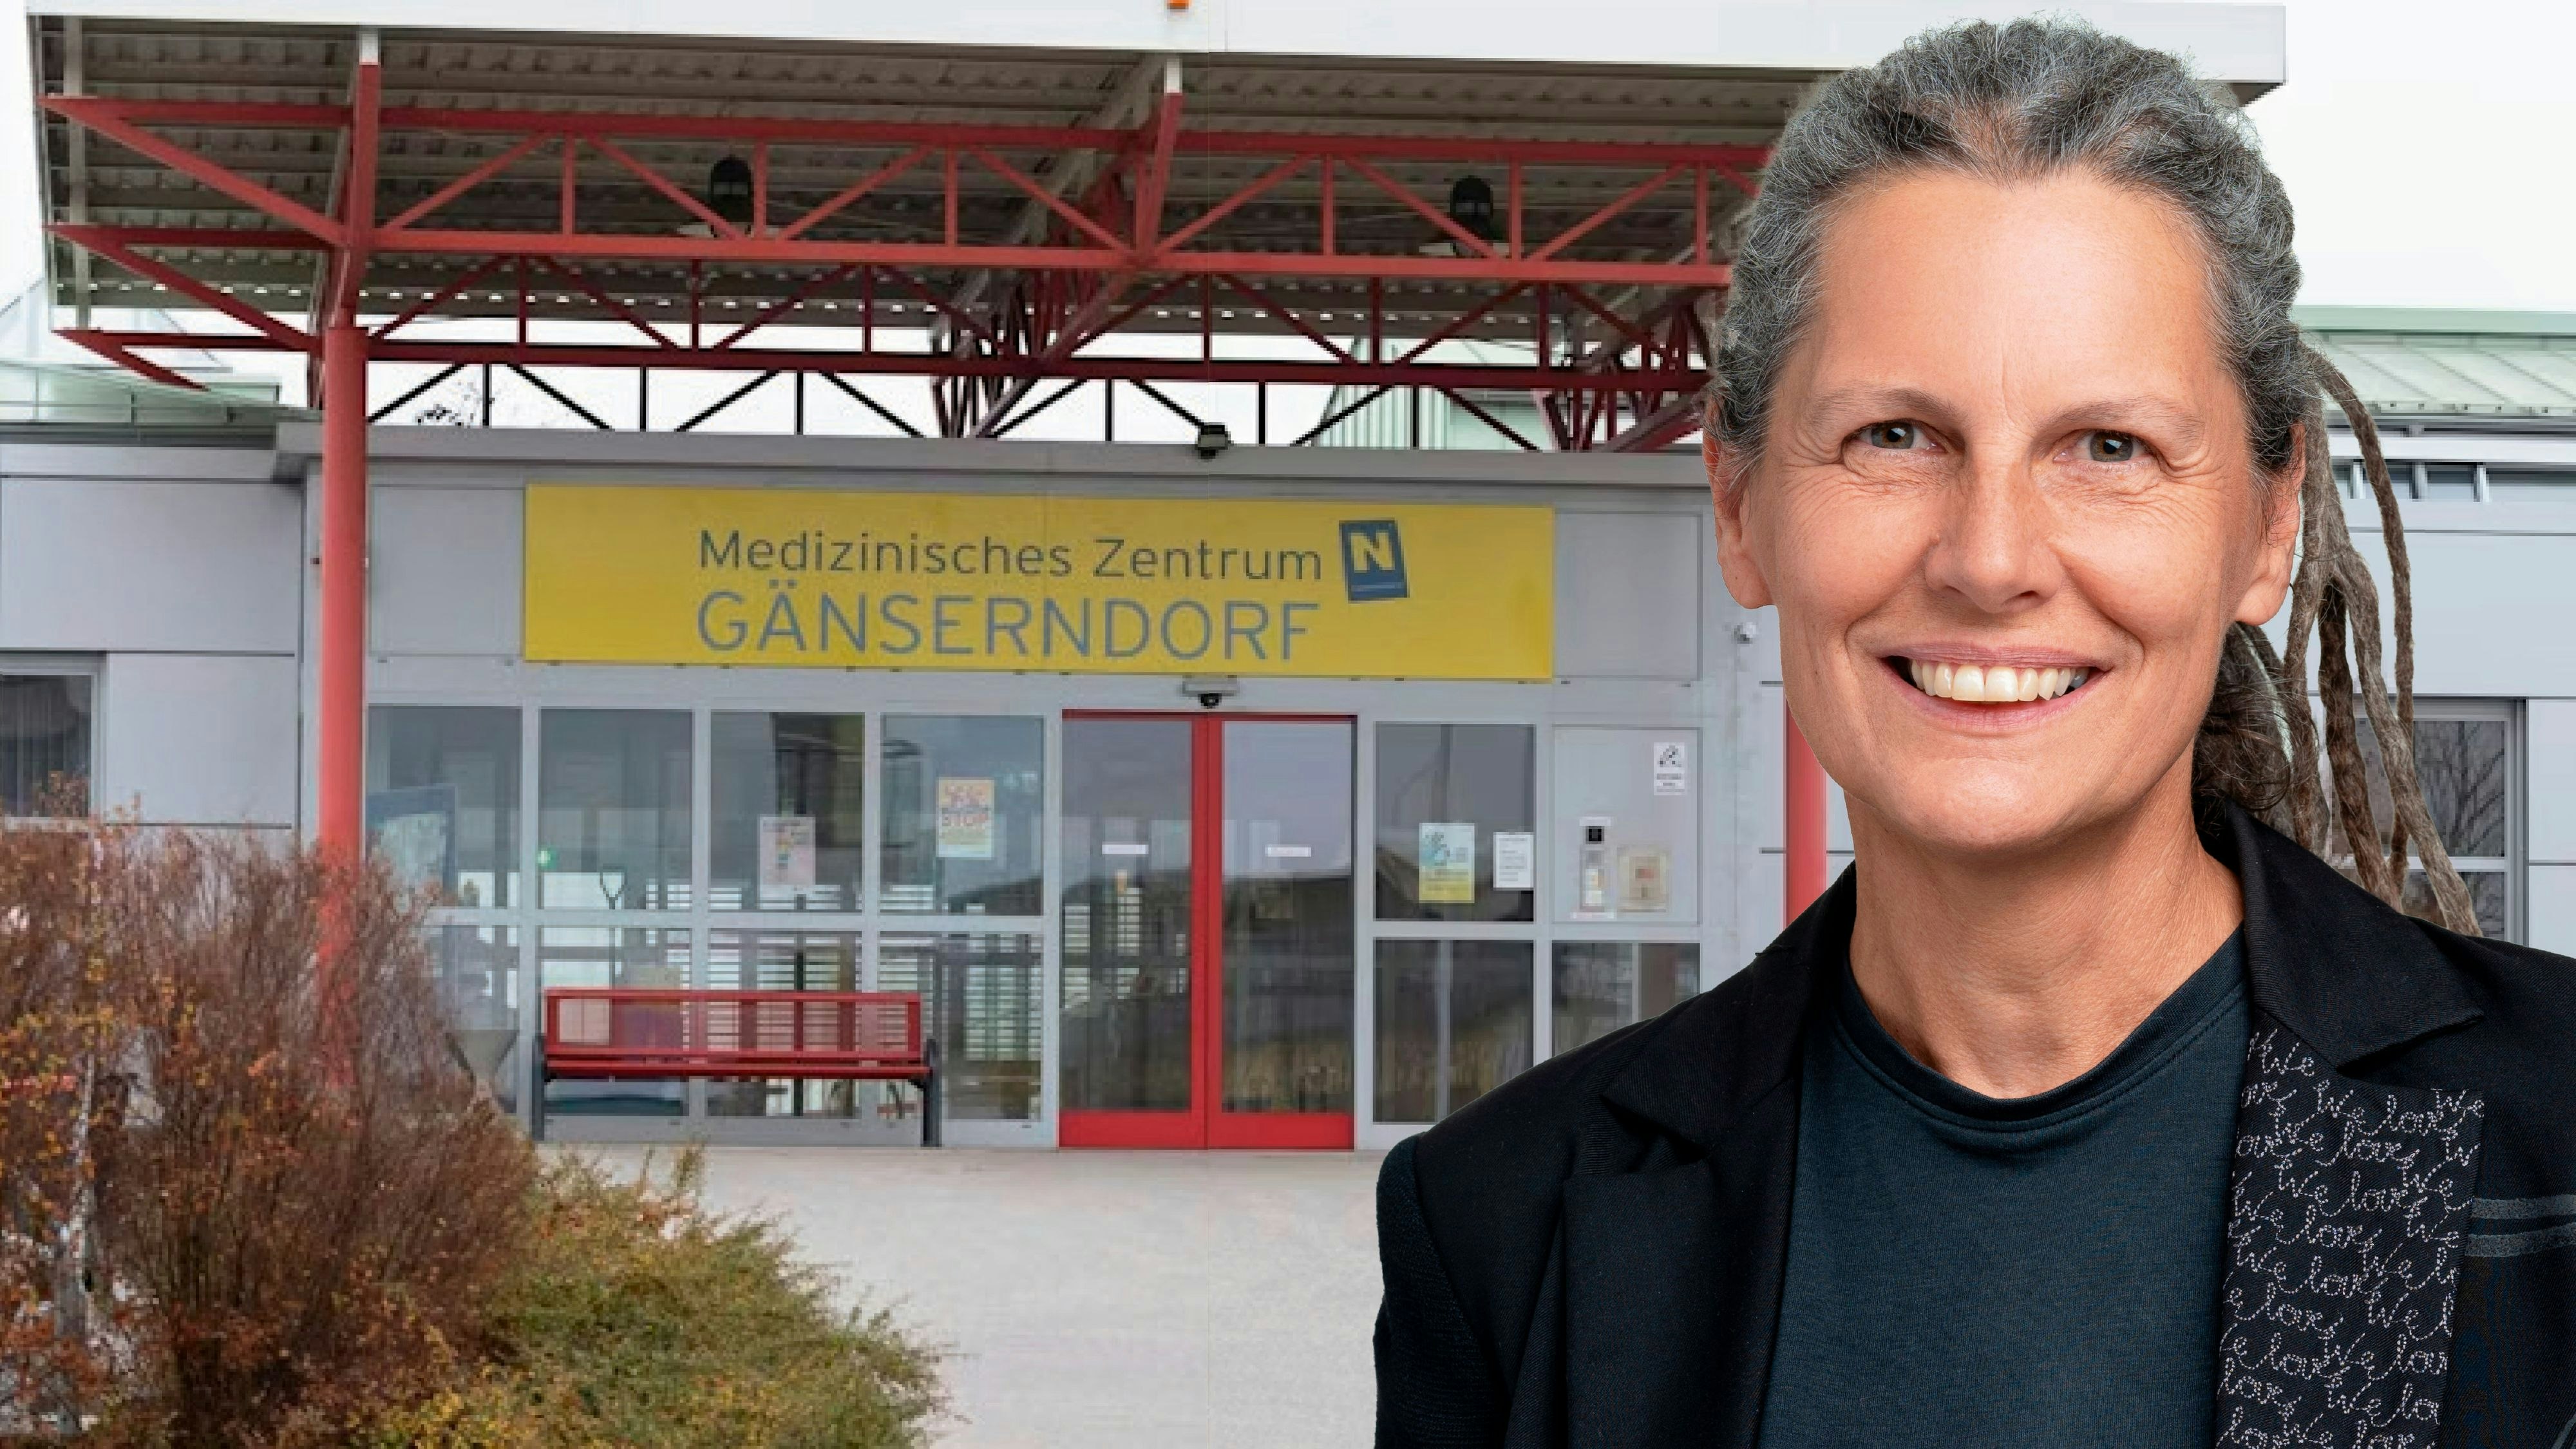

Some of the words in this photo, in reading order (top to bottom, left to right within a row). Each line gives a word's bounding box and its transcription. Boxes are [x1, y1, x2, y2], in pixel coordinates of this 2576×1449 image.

[700, 529, 1072, 578] Medizinisches
[1094, 538, 1322, 580] Zentrum
[1351, 532, 1396, 572] N
[697, 578, 1321, 661] GÄNSERNDORF
